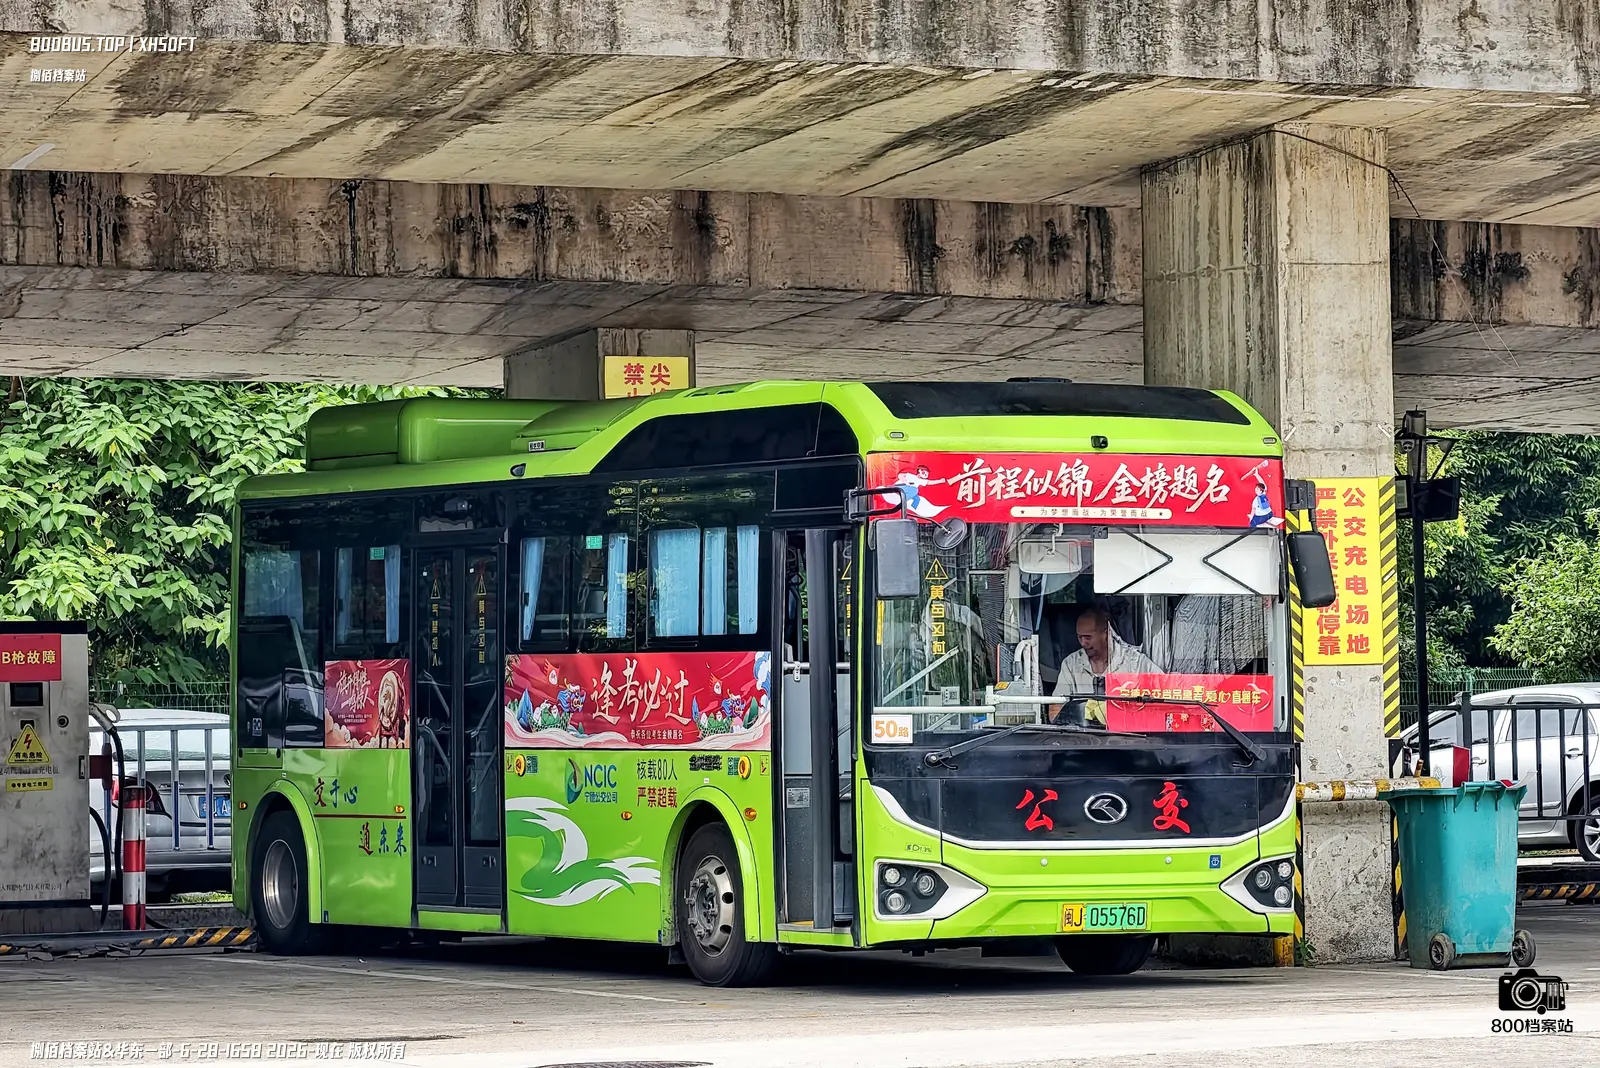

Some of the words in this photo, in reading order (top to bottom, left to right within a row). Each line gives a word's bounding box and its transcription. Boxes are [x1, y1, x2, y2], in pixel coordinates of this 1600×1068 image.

[947, 458, 1094, 510] 前程似锦
[1092, 459, 1231, 513] 金榜题名
[1342, 487, 1371, 654] 公交充电场地
[2, 650, 56, 665] B枪故障
[590, 657, 692, 726] 逢考必过
[14, 751, 43, 759] 有电危险
[584, 764, 617, 789] NCIC
[636, 759, 678, 780] 核载80人
[584, 791, 618, 803] 宁德公交公司
[636, 786, 678, 808] 严禁超载
